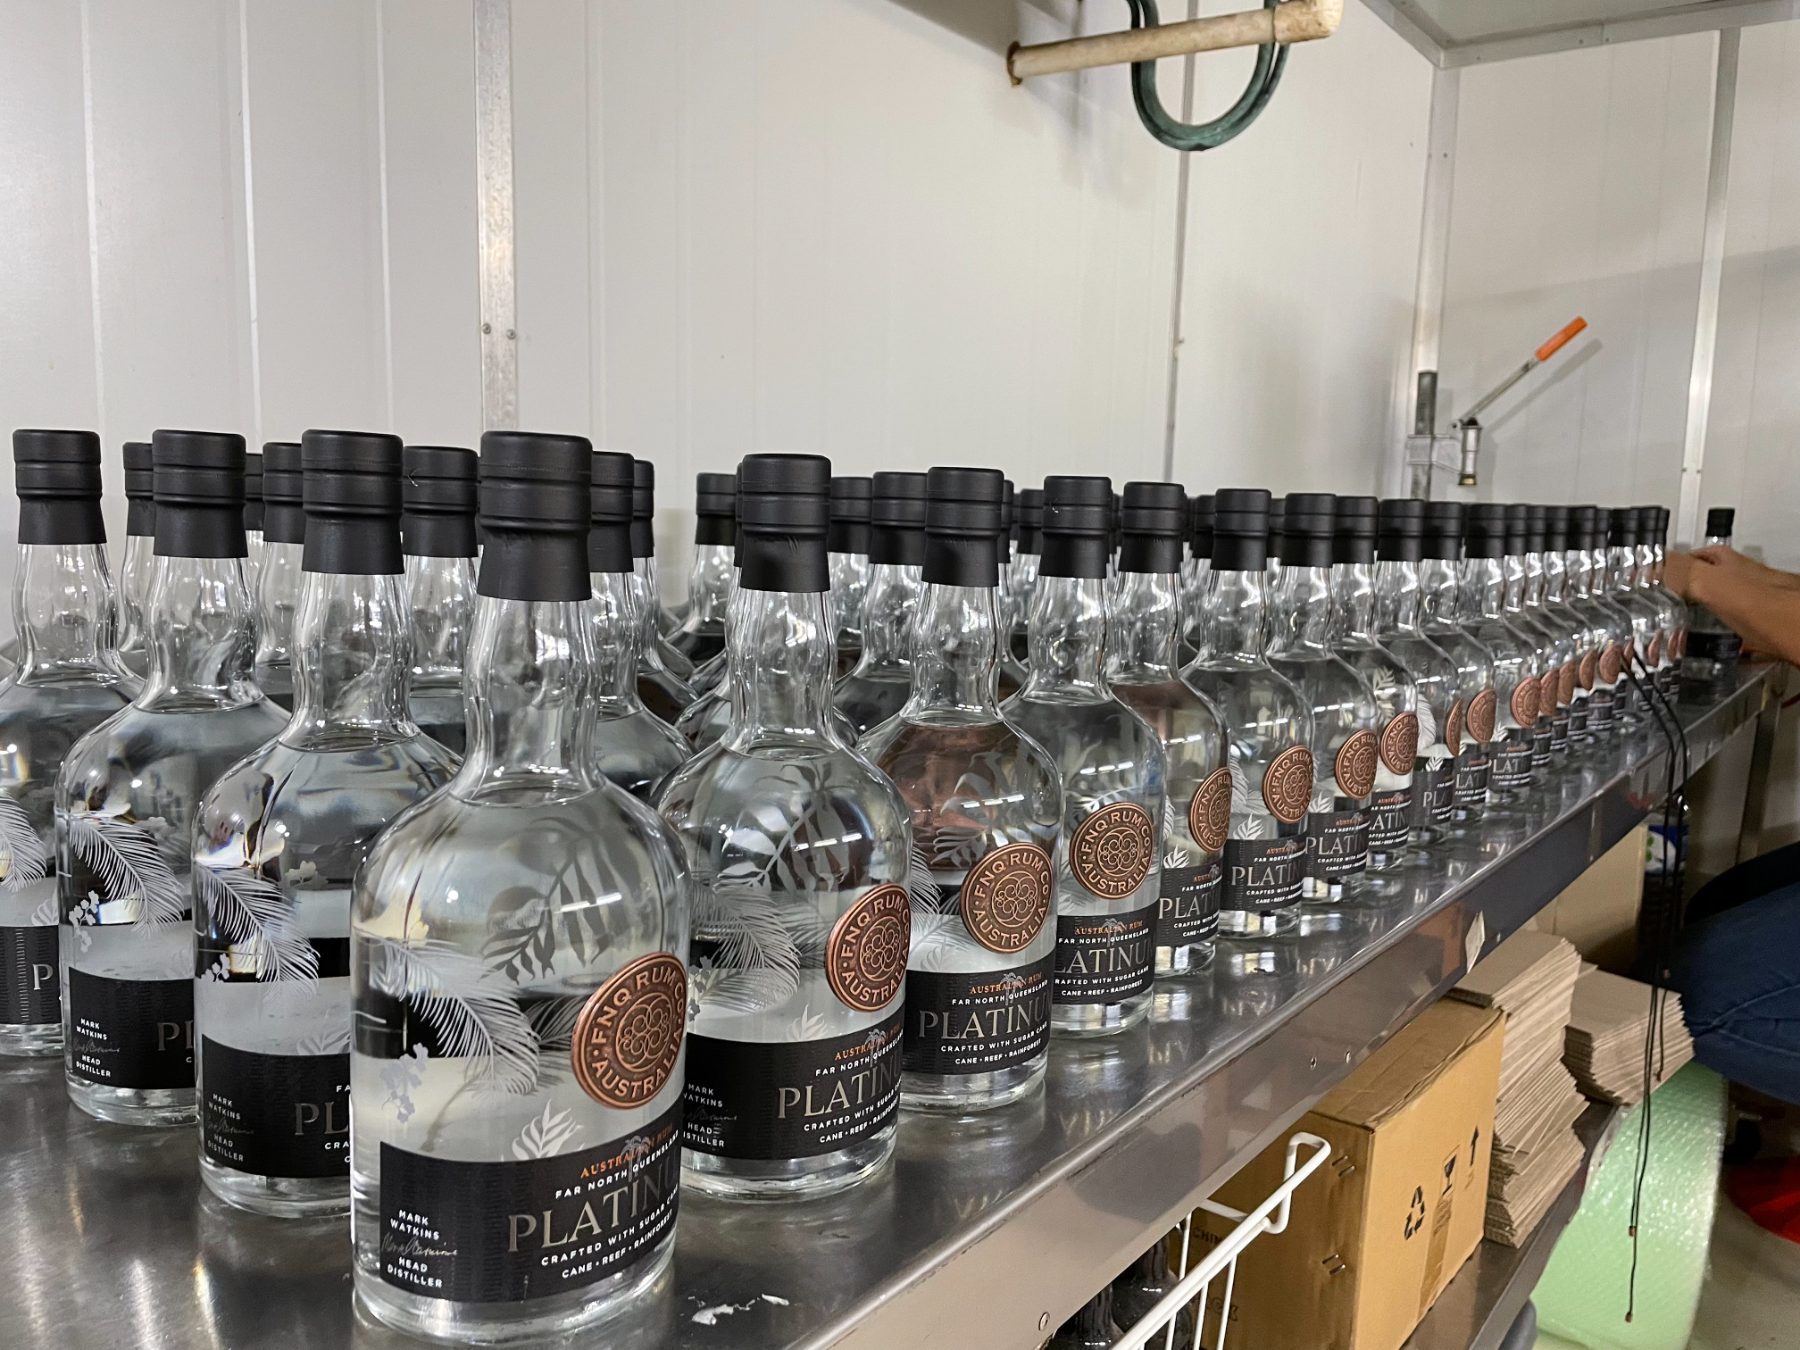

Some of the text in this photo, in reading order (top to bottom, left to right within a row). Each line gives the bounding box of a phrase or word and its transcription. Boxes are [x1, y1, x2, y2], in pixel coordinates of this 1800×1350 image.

[1272, 759, 1292, 786] FNQ
[1199, 783, 1217, 813] FNQ
[1081, 820, 1108, 853] FNQ
[1111, 811, 1143, 827] RUM
[974, 861, 1007, 898] FNQ
[1010, 852, 1044, 871] RUM
[1081, 856, 1150, 893] AUSTRALIA
[841, 911, 871, 958] FNQ
[874, 894, 903, 914] RUM
[973, 907, 1046, 947] AUSTRALIA
[1110, 928, 1149, 942] QUEENSLAND
[1173, 920, 1201, 929] CRAFTED
[841, 950, 908, 1003] AUSTRALIA
[1114, 972, 1136, 982] SUGAR
[975, 995, 1005, 1005] NORTH
[1008, 979, 1048, 1000] QUEENSLAND
[592, 988, 633, 1044] FNQ
[636, 966, 677, 990] RUM
[919, 991, 1051, 1039] PLATINU
[76, 1026, 108, 1040] WATKINS
[80, 1018, 100, 1029] MARK
[954, 1038, 1042, 1065] CANE REEF RAINFOREST
[988, 1038, 1010, 1049] WITH
[1013, 1031, 1035, 1044] SUGAR
[76, 1061, 111, 1077] DISTILLER
[82, 1055, 101, 1065] HEAD
[592, 1027, 683, 1098] AUSTRALIA
[815, 1066, 836, 1077] FAR
[840, 1056, 870, 1072] NORTH
[688, 1083, 714, 1096] MARK
[778, 1052, 900, 1119] PLATINU
[208, 1101, 241, 1120] WATKINS
[213, 1093, 233, 1107] MARK
[688, 1122, 713, 1135] HEAD
[803, 1115, 850, 1131] CRAFTED
[854, 1105, 874, 1119] WITH
[214, 1134, 234, 1148] HEAD
[683, 1130, 725, 1147] ISTILLER
[819, 1131, 843, 1143] CANE
[849, 1121, 868, 1135] REEF
[207, 1140, 244, 1162] DISTILLER
[555, 1185, 581, 1199] FAR
[587, 1168, 628, 1191] NORTH
[508, 1148, 679, 1253] PLATINU
[390, 1218, 440, 1240] WATKINS
[399, 1209, 429, 1226] MARK
[541, 1242, 602, 1267] CRAFTED
[608, 1227, 635, 1246] WITH
[639, 1204, 665, 1229] SUGAR
[562, 1208, 673, 1279] CANE REEF RAINFOREST
[387, 1263, 443, 1288] DISTILLER
[399, 1256, 428, 1273] HEAD
